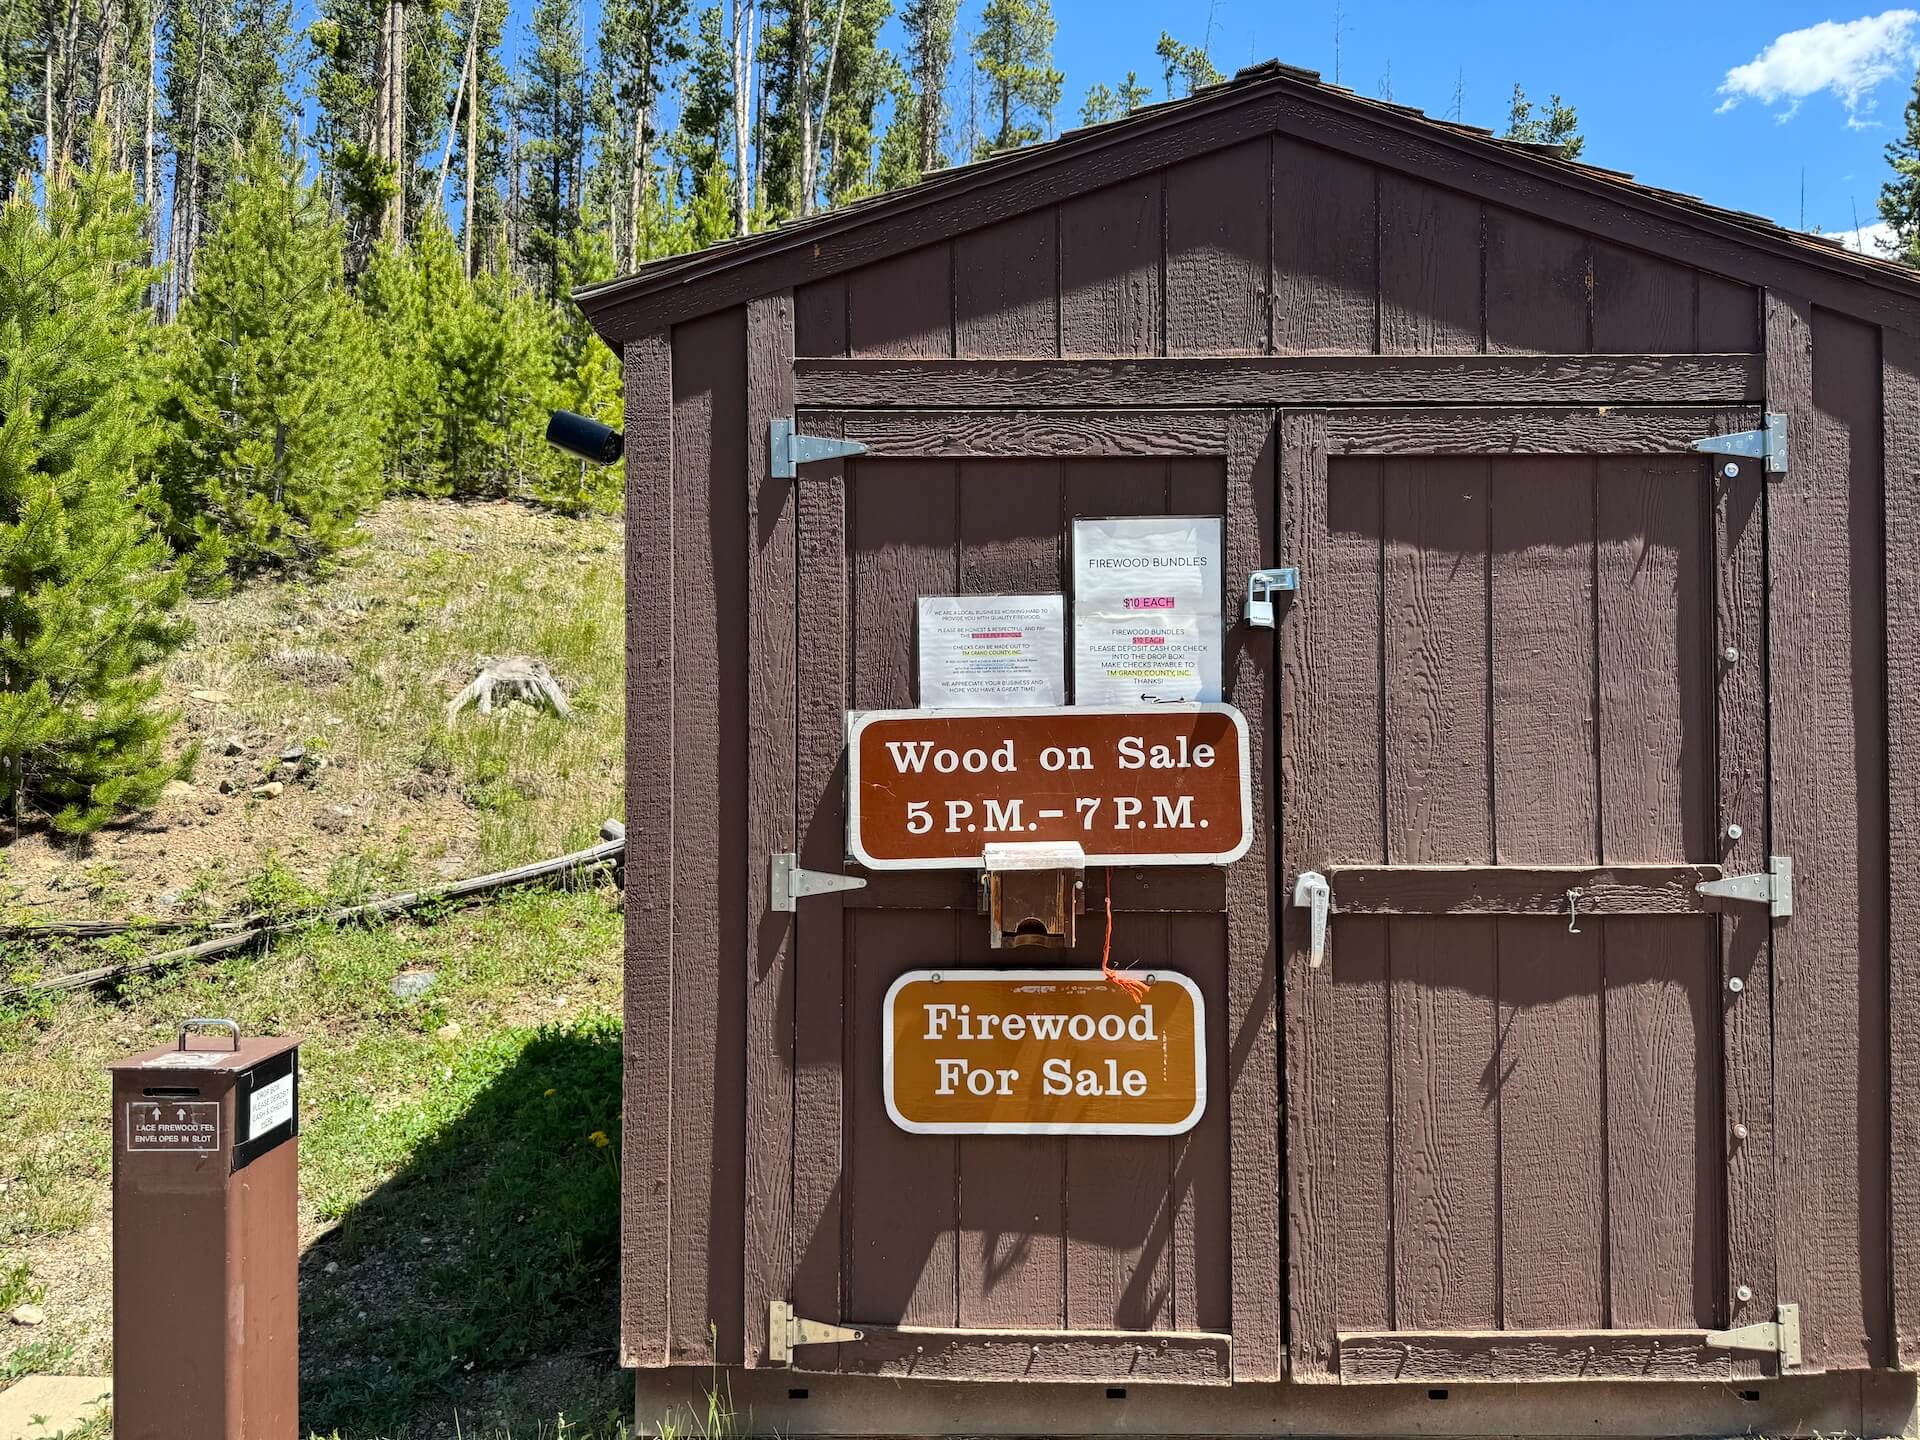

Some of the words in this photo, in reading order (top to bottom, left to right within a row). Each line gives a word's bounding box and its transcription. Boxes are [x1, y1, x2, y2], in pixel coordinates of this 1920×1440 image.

[1089, 558, 1149, 568] FIREWOOD
[1153, 556, 1208, 567] BUNDLES
[1123, 598, 1140, 608] $10
[1144, 597, 1174, 607] EACH
[885, 740, 1018, 774] Wood
[1039, 745, 1094, 772] on
[1117, 736, 1215, 770] Sale
[906, 801, 934, 835] 5
[1075, 797, 1101, 830] 7
[1113, 795, 1209, 830] P.M.
[922, 1003, 1158, 1042] Firewood
[934, 1058, 1019, 1096] For
[1042, 1058, 1148, 1097] Sale
[270, 1098, 289, 1113] CHECKS
[158, 1124, 198, 1132] FIREWOOD
[135, 1135, 179, 1143] ENVELOPES
[181, 1135, 189, 1143] IN
[192, 1135, 212, 1143] SLOT
